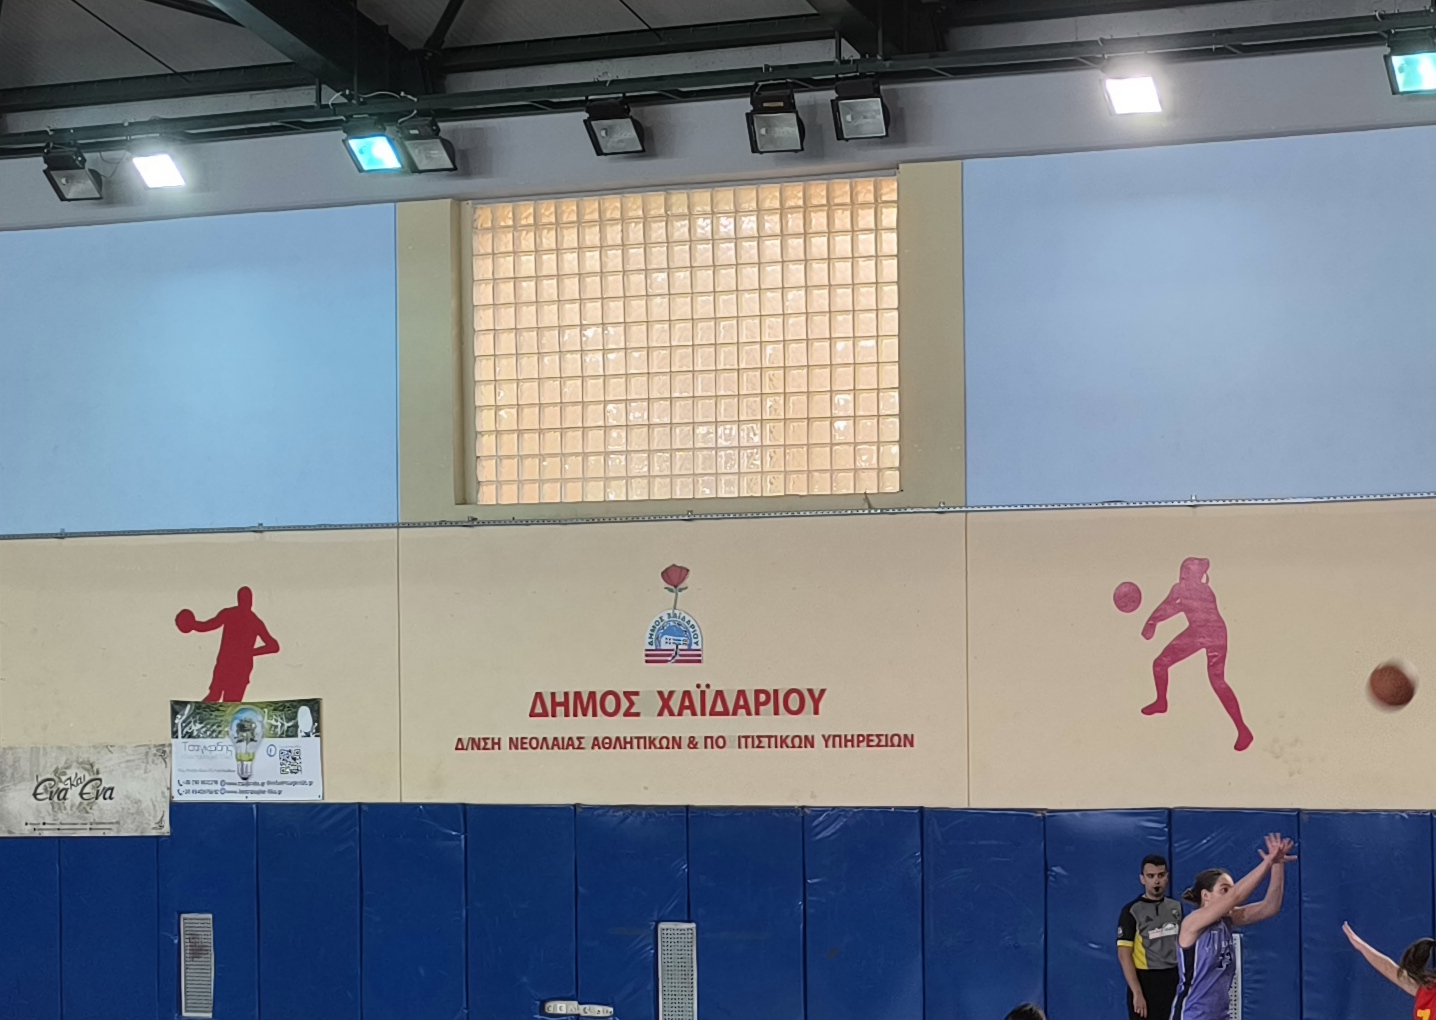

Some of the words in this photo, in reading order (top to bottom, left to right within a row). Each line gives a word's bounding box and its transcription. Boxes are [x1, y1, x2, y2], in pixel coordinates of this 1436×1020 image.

[528, 690, 641, 718] ΔΗΜΟΣ
[656, 682, 827, 717] ΧΑΪΔΑΡΙΟΥ
[454, 737, 501, 752] Δ/ΝΣΗ
[508, 736, 586, 751] ΝΕΟΛΑΙΑΣ
[591, 735, 683, 750] ΑΘΛΗΤΙΚΩΝ
[687, 735, 699, 750] &
[822, 733, 915, 749] ΥΠΗΡΕΣΙΩΝ
